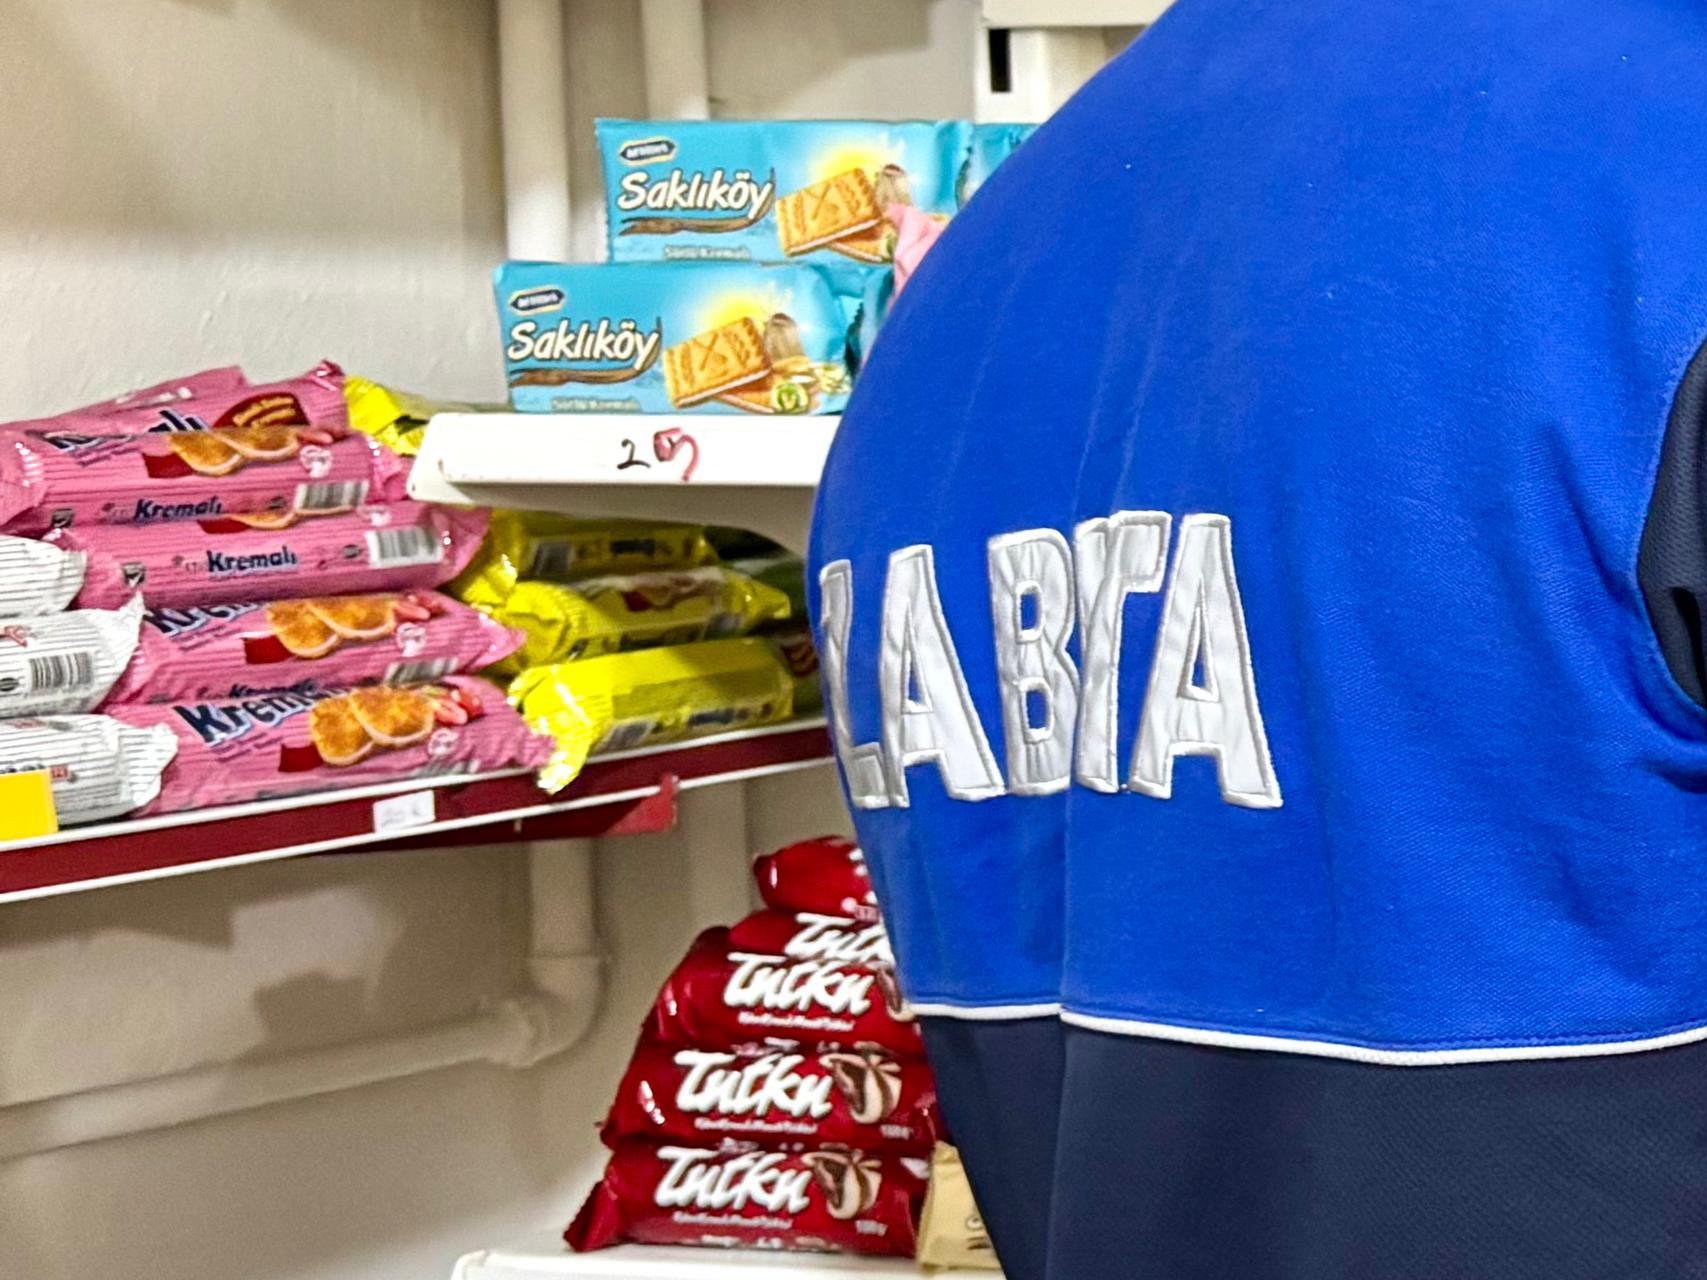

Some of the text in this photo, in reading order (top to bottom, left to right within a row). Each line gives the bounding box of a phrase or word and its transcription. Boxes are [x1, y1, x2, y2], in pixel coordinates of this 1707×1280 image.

[617, 168, 775, 220] Saklıköy
[507, 317, 662, 368] Saklıköy
[206, 546, 298, 572] Kremalı
[723, 951, 878, 1015] Tutku
[673, 1050, 834, 1118] Tutku
[653, 1145, 813, 1213] Tutku
